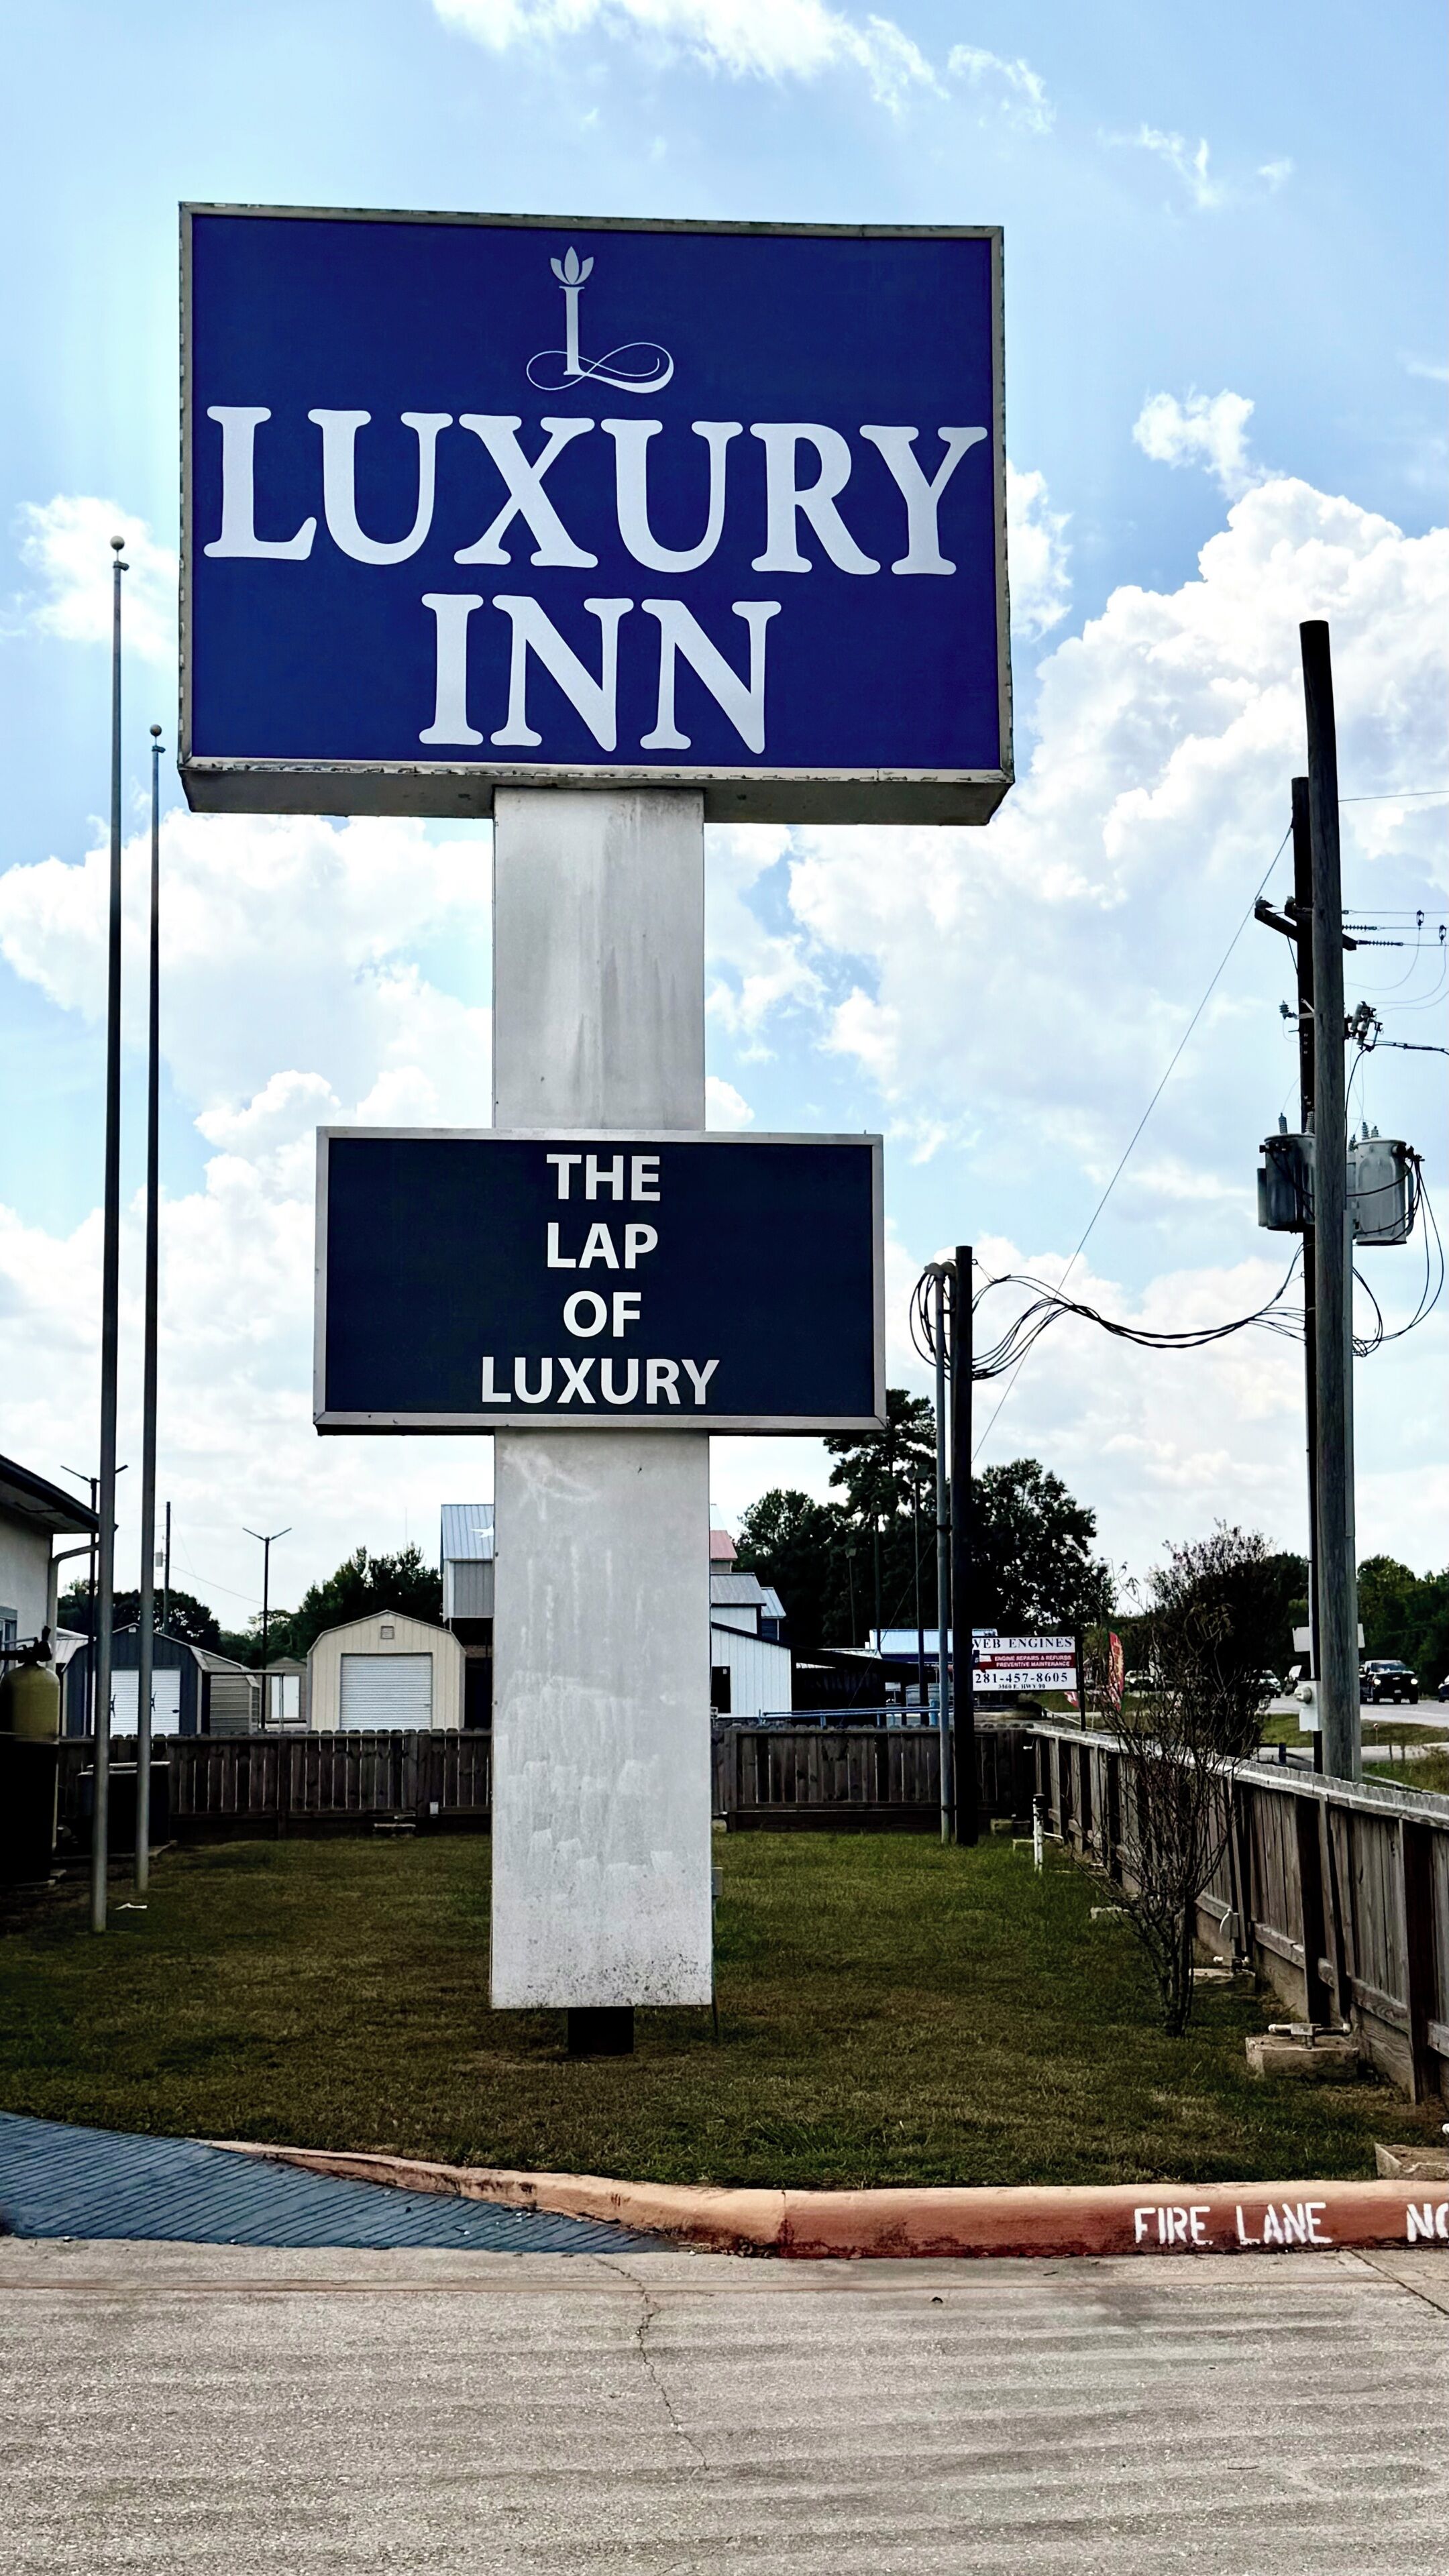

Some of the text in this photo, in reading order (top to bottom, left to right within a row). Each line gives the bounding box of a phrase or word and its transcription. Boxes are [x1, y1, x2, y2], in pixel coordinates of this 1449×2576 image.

[203, 406, 987, 575] LUXURY
[419, 593, 782, 754] INN
[546, 1154, 661, 1201] THE
[547, 1222, 658, 1269] LAP
[563, 1290, 641, 1338] OF
[482, 1356, 720, 1405] LUXURY
[1008, 1638, 1072, 1648] ENGINES
[975, 1672, 1068, 1684] 281-457-8605
[1134, 2206, 1214, 2245] FIRE
[1236, 2202, 1334, 2245] LANE
